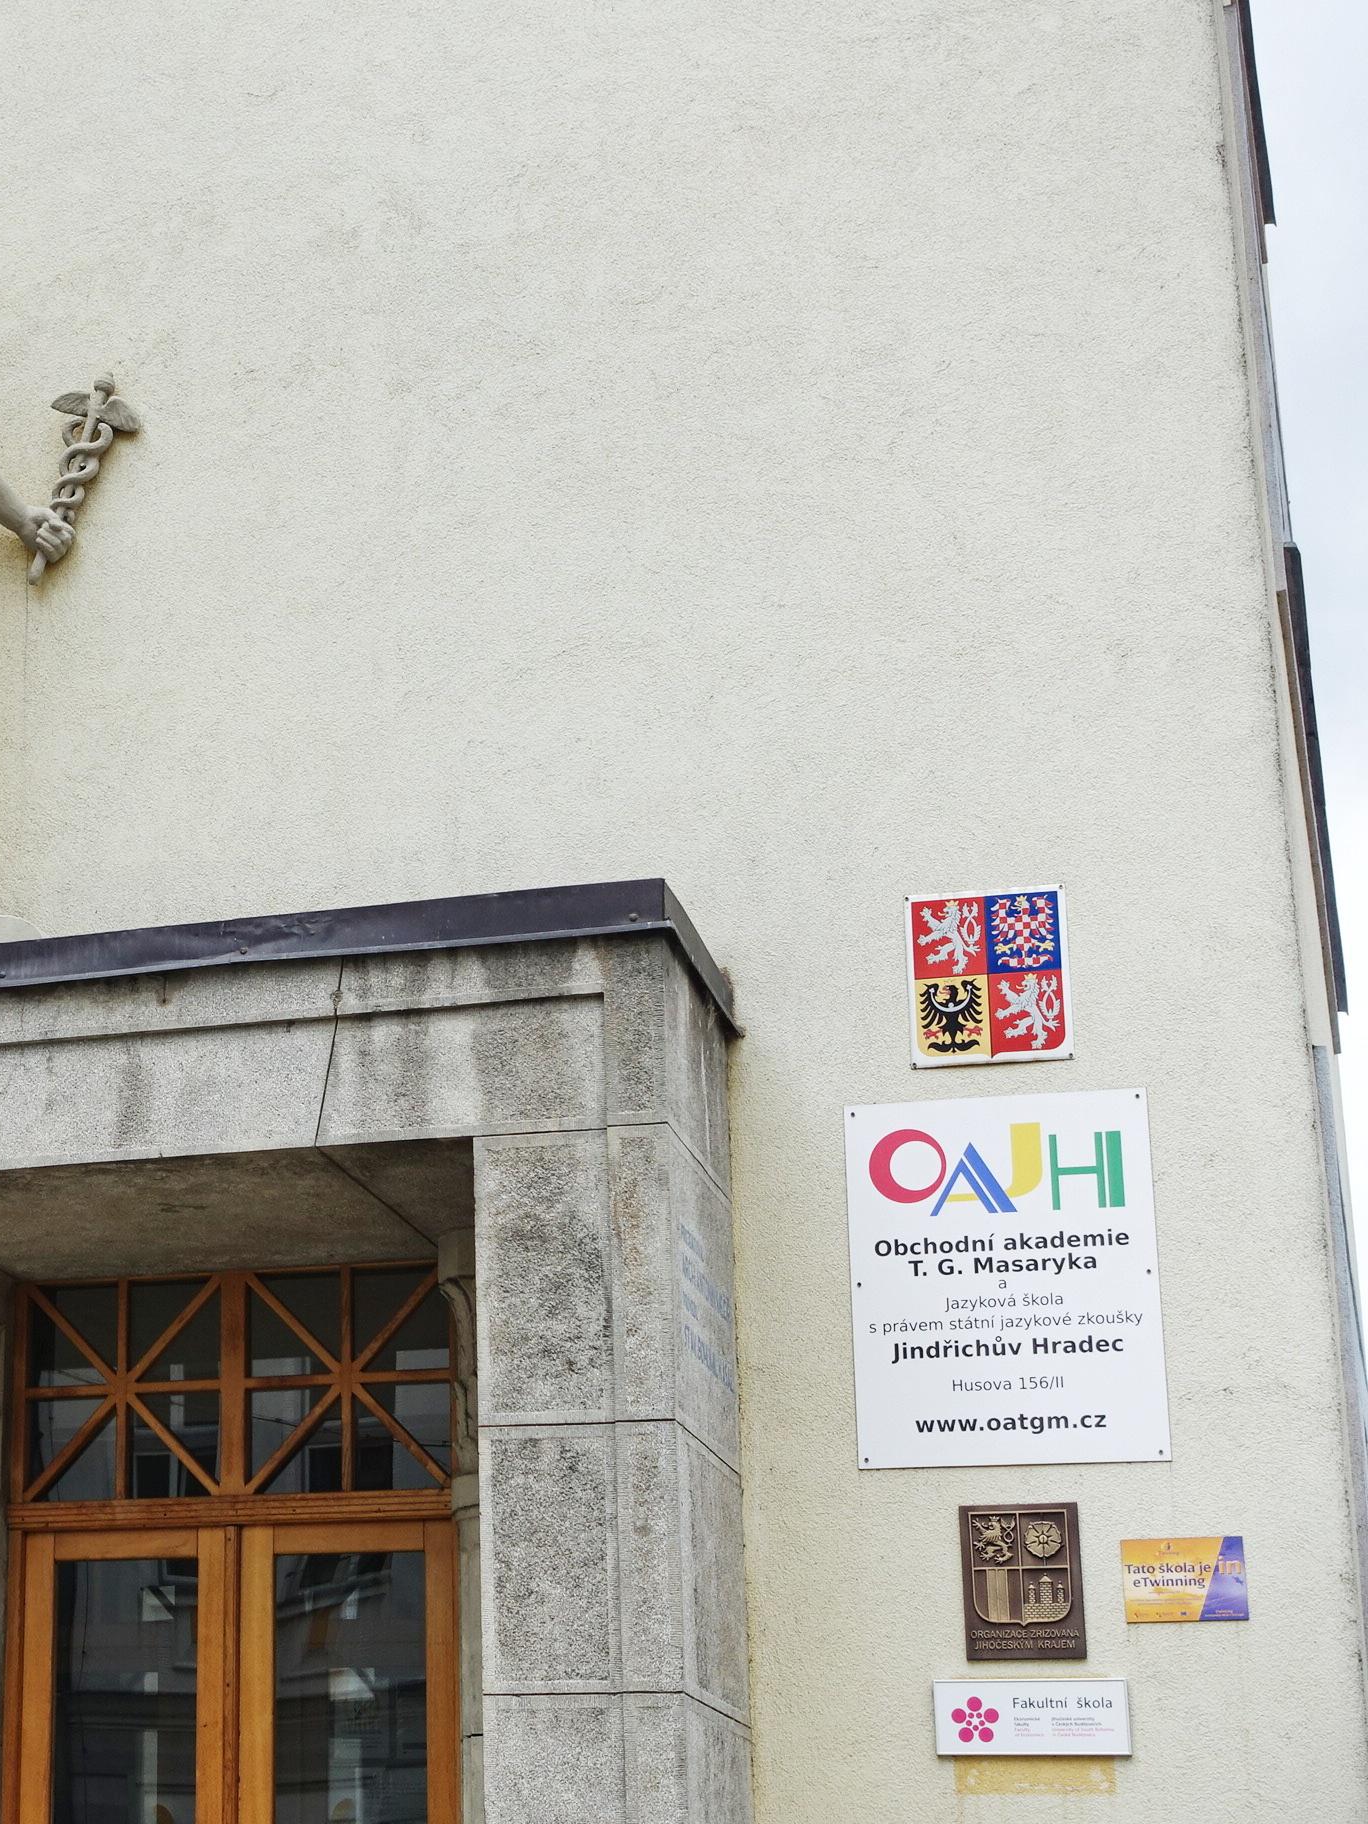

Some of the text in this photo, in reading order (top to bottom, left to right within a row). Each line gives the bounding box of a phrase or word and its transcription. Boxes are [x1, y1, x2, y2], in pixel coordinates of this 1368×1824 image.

[875, 1229, 1129, 1257] Obchodní akademie
[908, 1253, 1098, 1276] T. G. Masaryka
[999, 1280, 1006, 1289] a
[945, 1293, 1063, 1312] Jazyková škola
[870, 1311, 1142, 1335] s právem státní jazykové zkoušky
[892, 1335, 1123, 1364] Jindřichův Hradec
[953, 1380, 1011, 1391] Husova
[915, 1414, 1106, 1434] www.oatgm.cz
[1124, 1564, 1155, 1574] Tato
[1159, 1563, 1195, 1573] škola
[1199, 1562, 1211, 1576] je
[1133, 1576, 1206, 1588] eTwinning
[971, 1630, 1028, 1638] ORGANIZACE
[1038, 1640, 1076, 1648] KRAJEM
[1013, 1697, 1112, 1708] Fakultní škola
